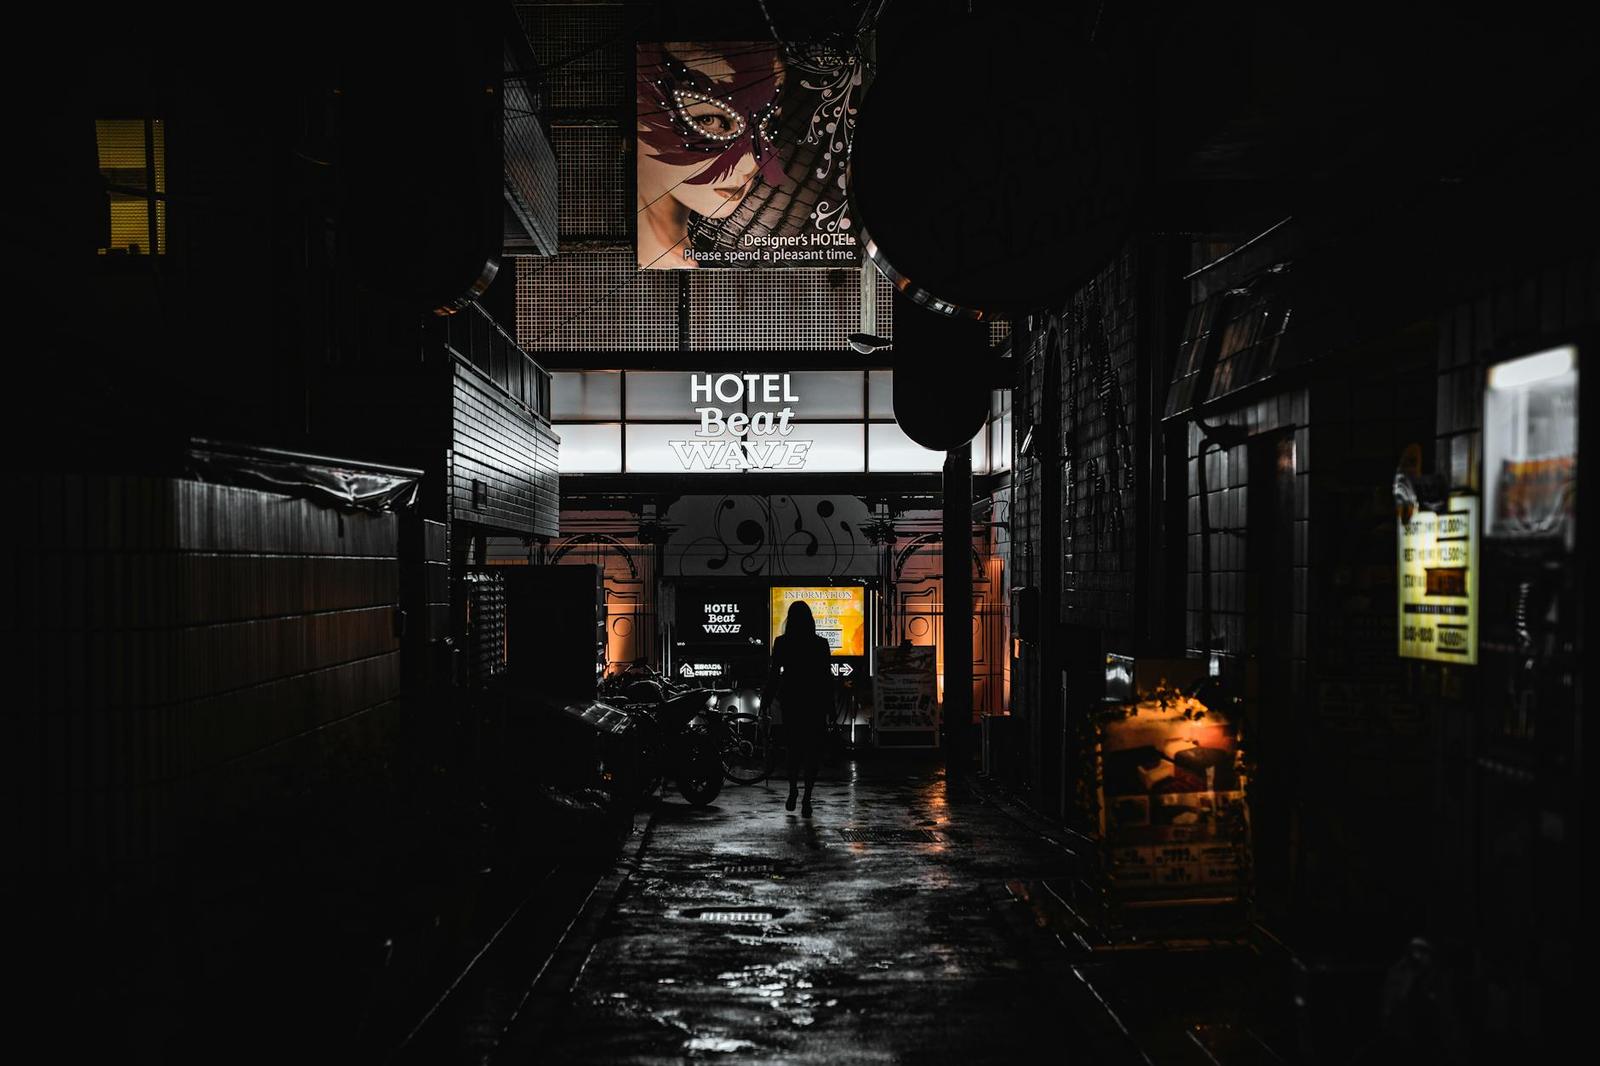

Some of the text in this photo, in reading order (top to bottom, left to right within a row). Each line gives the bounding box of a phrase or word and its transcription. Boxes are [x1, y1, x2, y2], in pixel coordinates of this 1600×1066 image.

[744, 233, 808, 249] Designer's
[684, 248, 857, 263] Please spend a pleasant time.
[690, 373, 800, 403] HOTEL
[694, 407, 796, 438] Beat
[668, 439, 814, 470] WAVE
[784, 590, 853, 600] INFORMATION
[704, 603, 740, 613] HOTEL
[707, 613, 736, 623] Beat
[702, 624, 742, 634] WAVE
